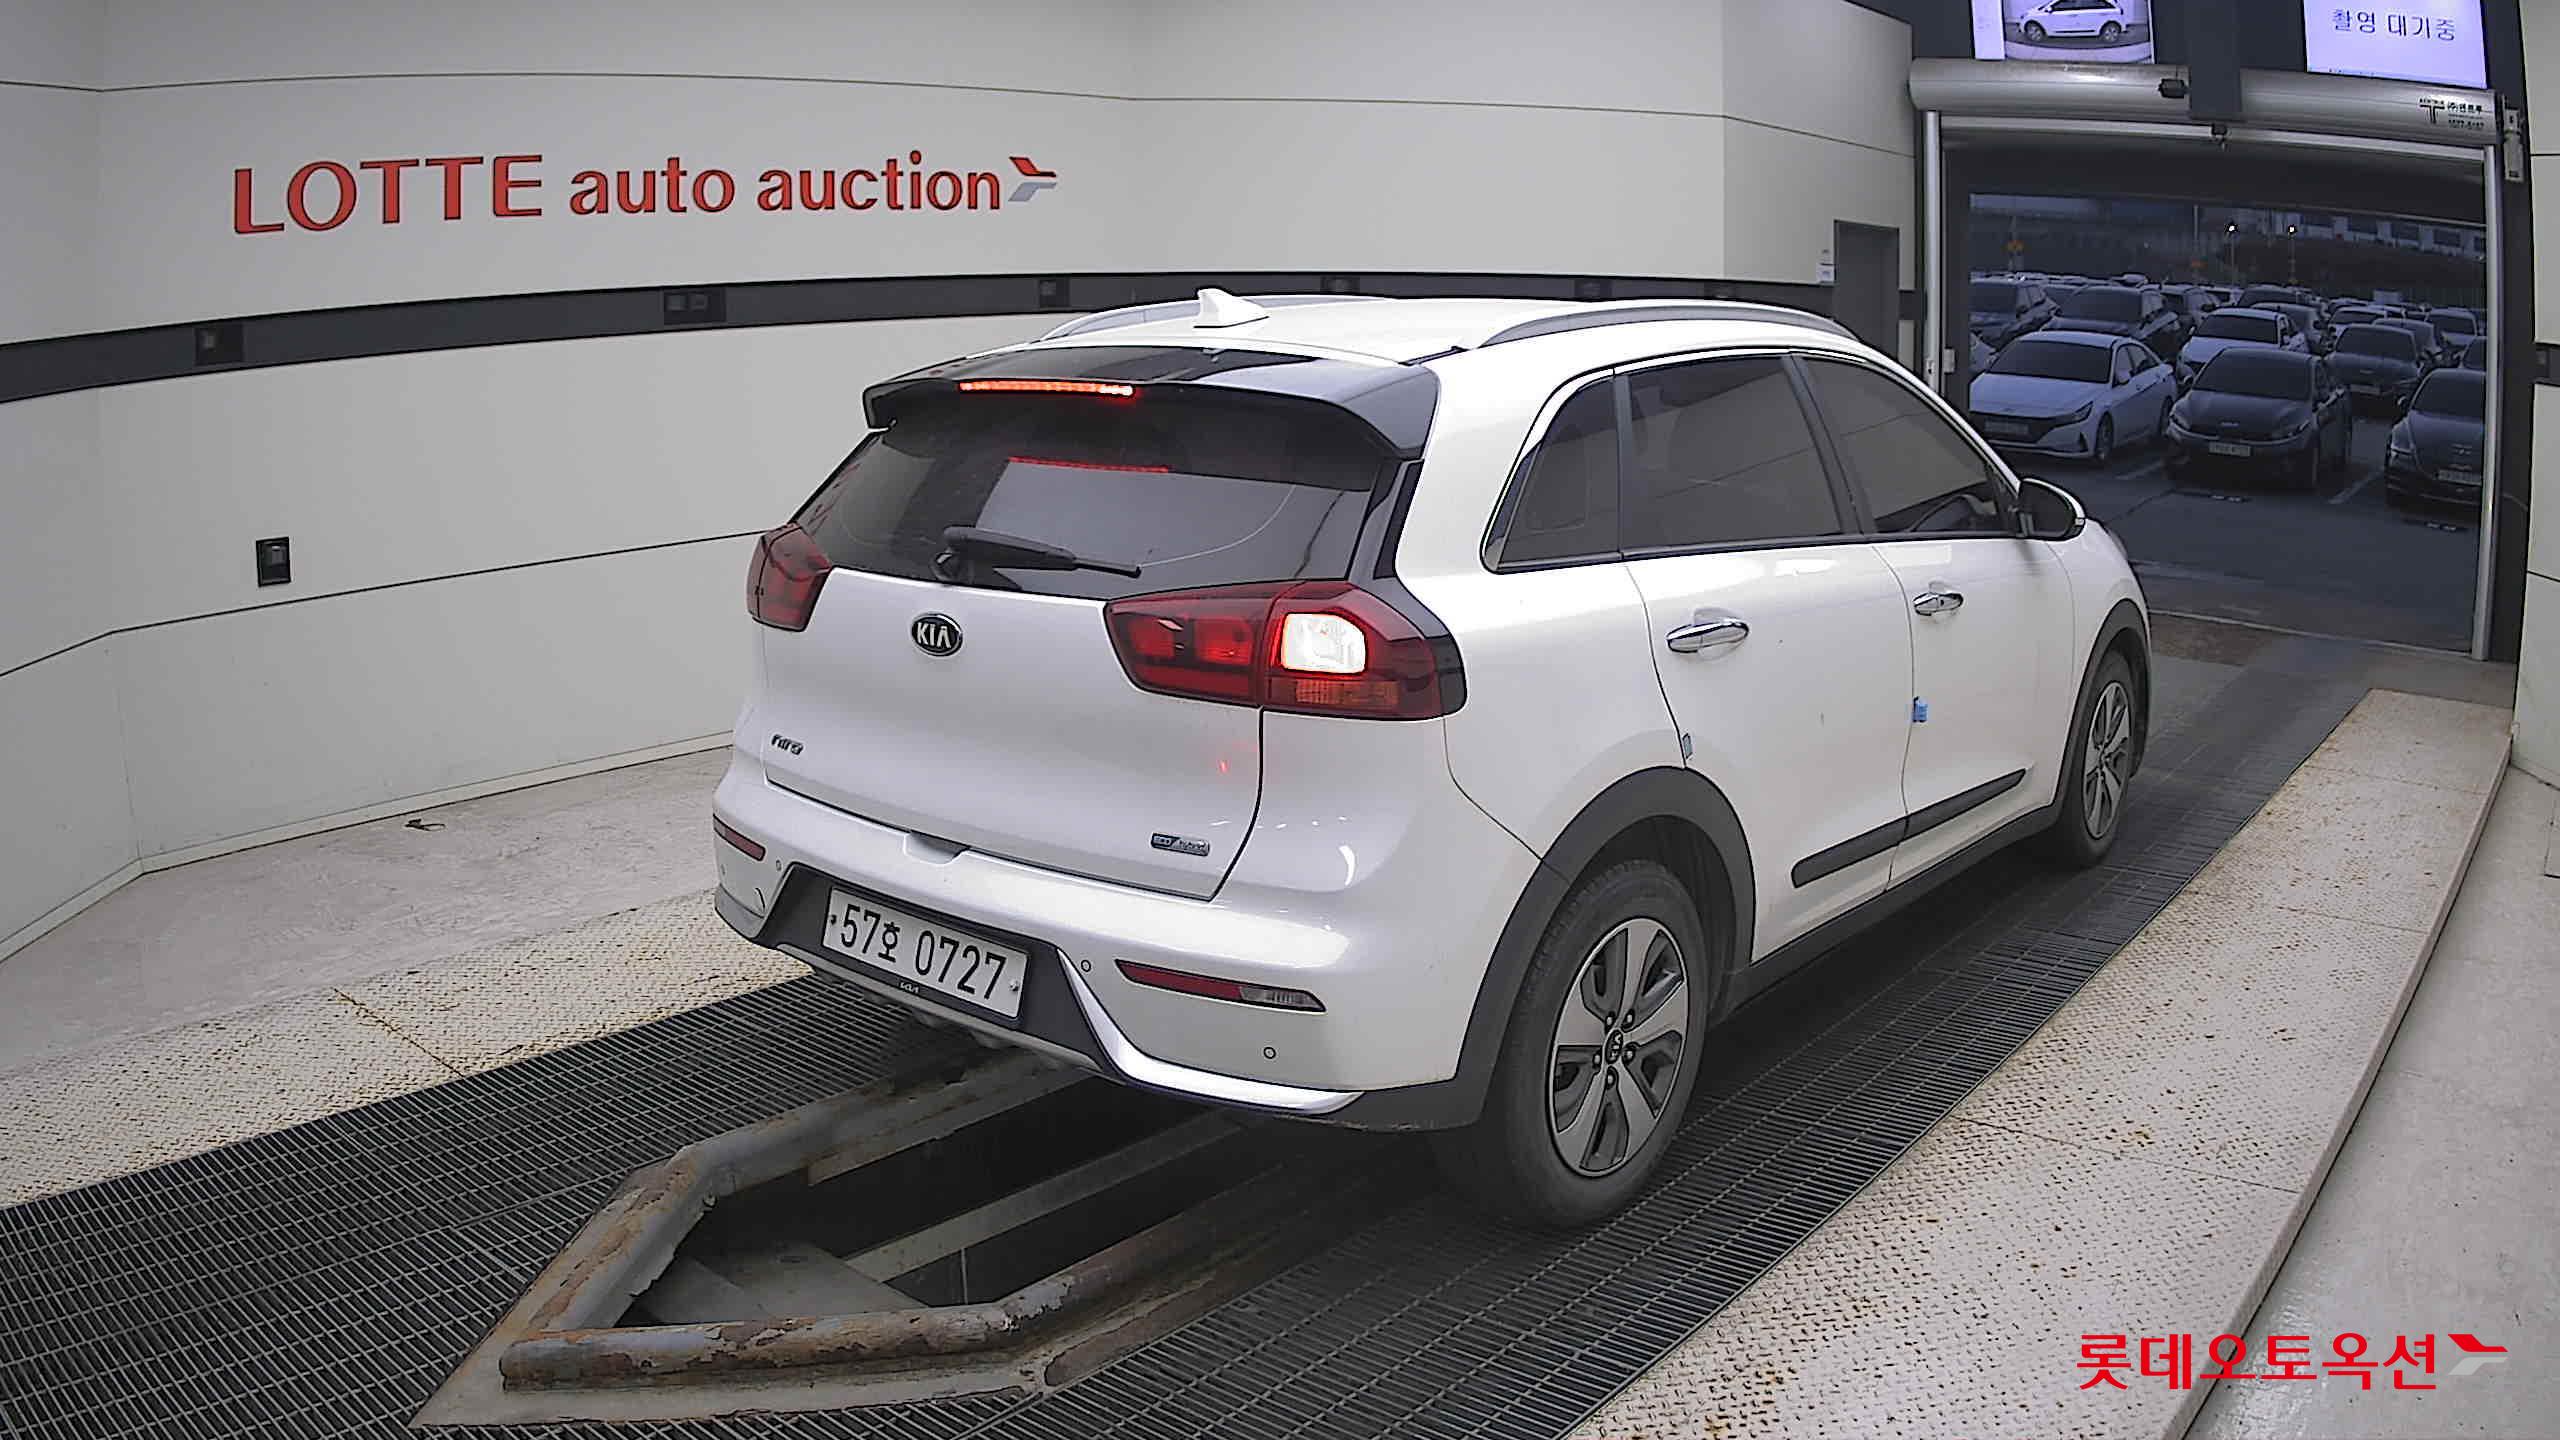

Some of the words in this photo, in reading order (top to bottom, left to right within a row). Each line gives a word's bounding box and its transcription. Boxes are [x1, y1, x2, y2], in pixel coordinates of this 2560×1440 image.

[2331, 8, 2377, 34] 촬영
[2387, 13, 2456, 42] 대기중
[234, 155, 543, 235] LOTTE
[569, 157, 736, 215] auto
[757, 150, 1001, 211] auction
[916, 621, 952, 649] KIA
[840, 903, 901, 963] 57호
[915, 929, 1007, 1000] 0727
